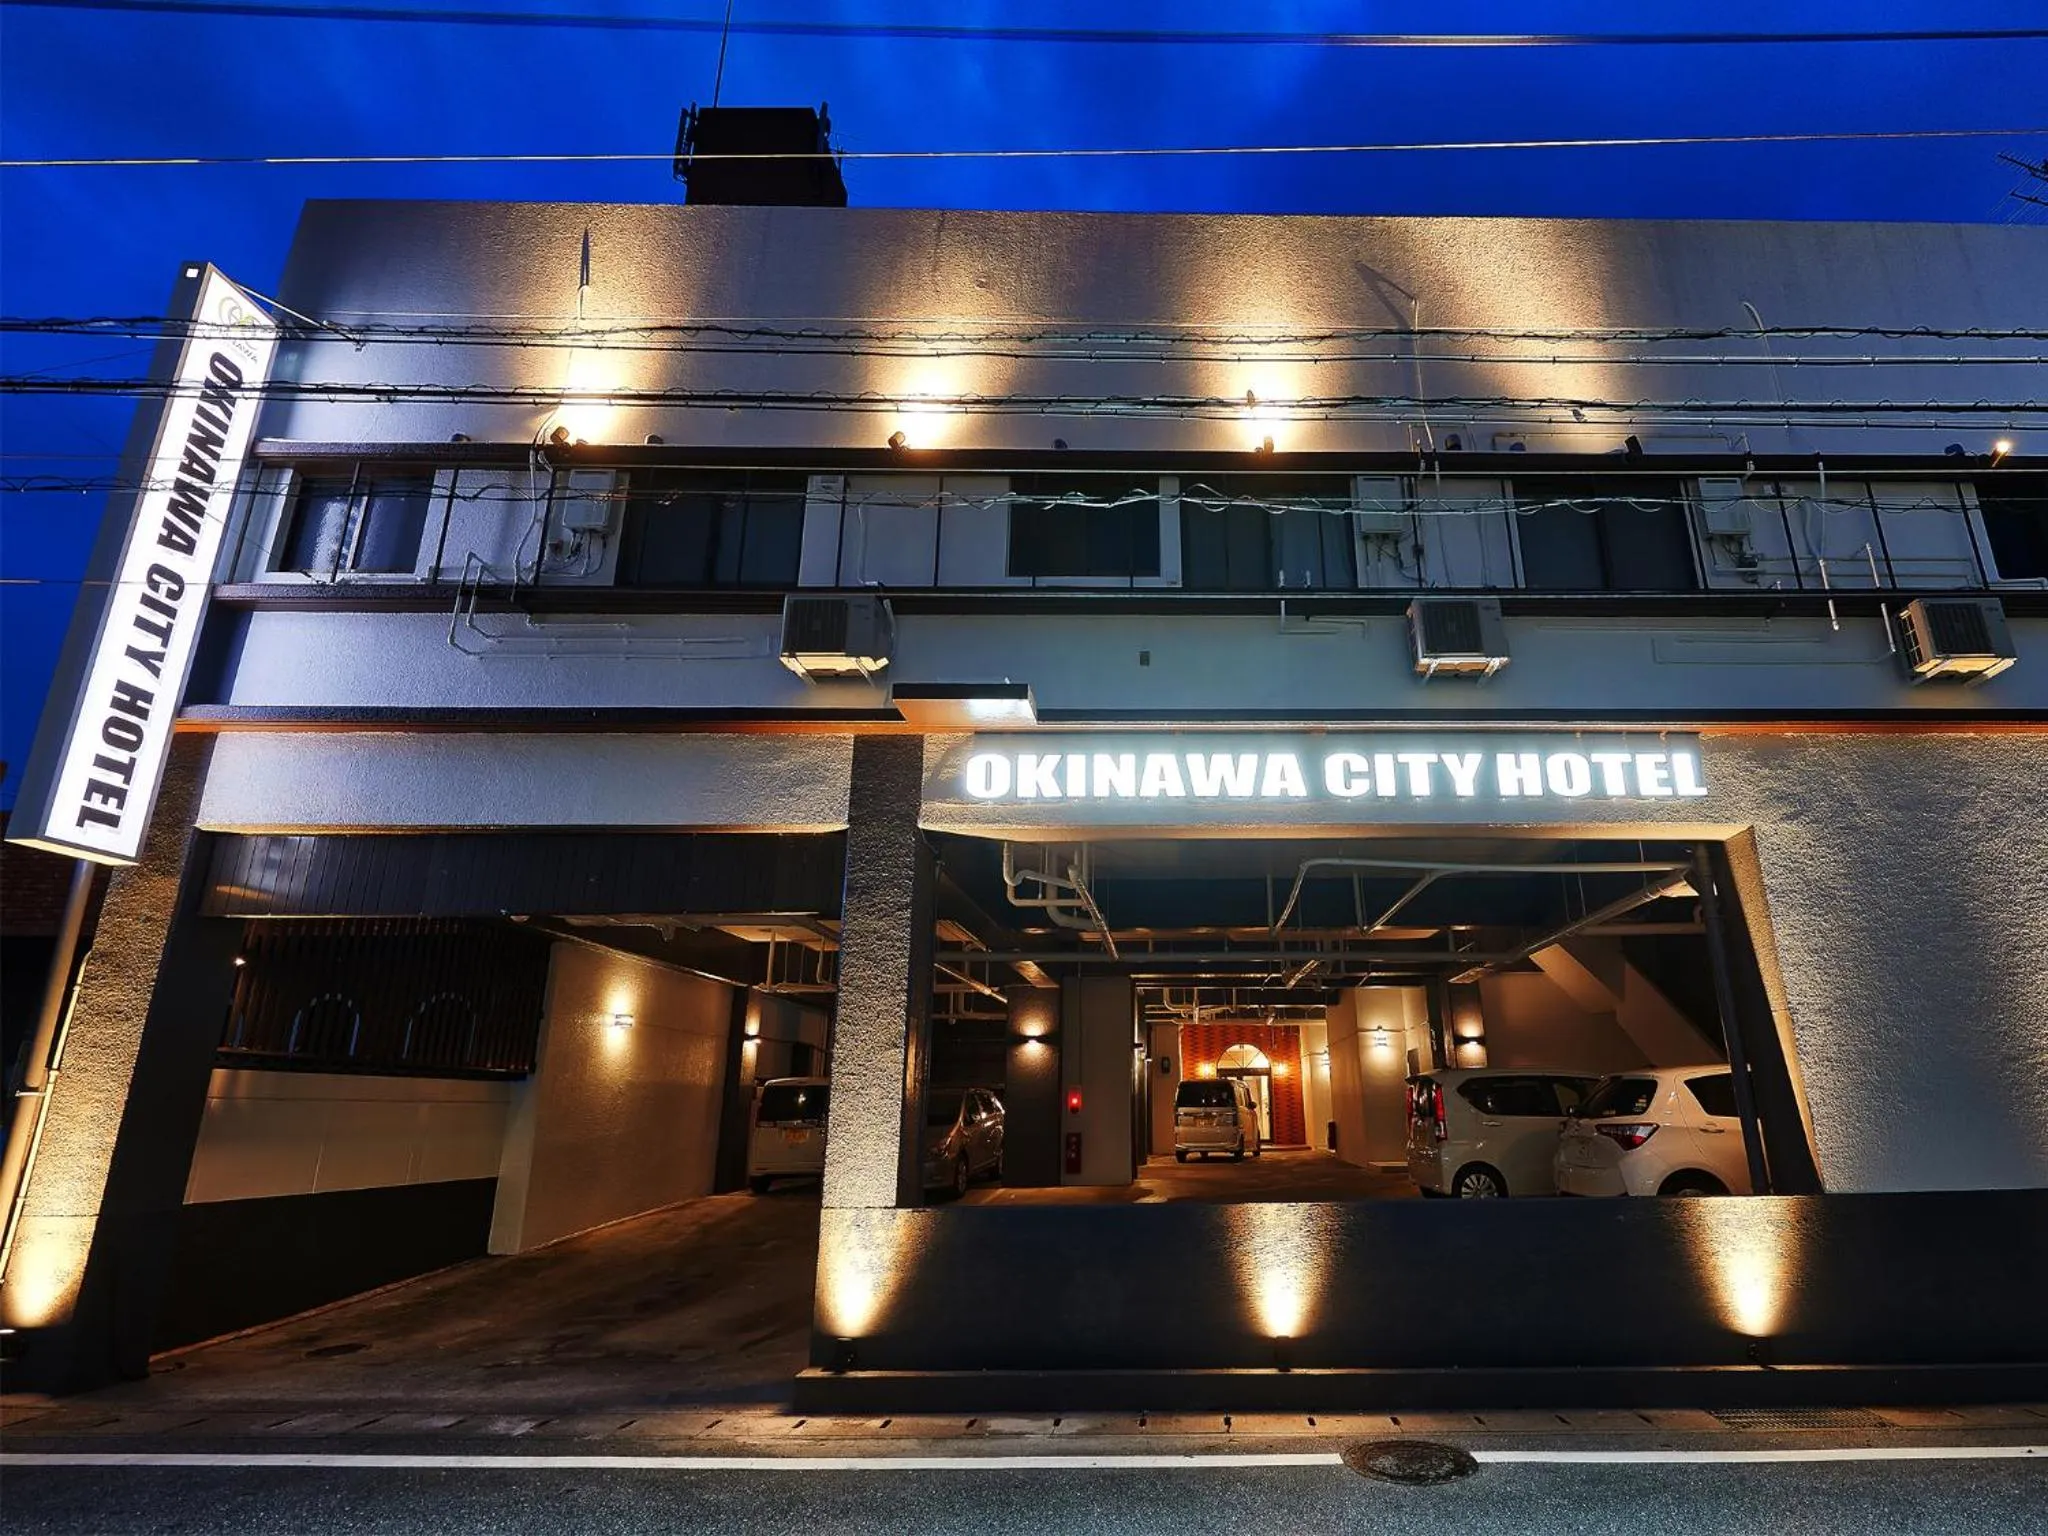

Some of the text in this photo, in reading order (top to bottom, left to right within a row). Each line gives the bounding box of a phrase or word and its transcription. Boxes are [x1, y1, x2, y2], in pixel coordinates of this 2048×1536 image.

[157, 351, 243, 556] OKINAWA
[124, 563, 185, 679] CITY
[76, 679, 154, 829] HOTEL
[965, 751, 1709, 799] OKINAWA CITY HOTEL
